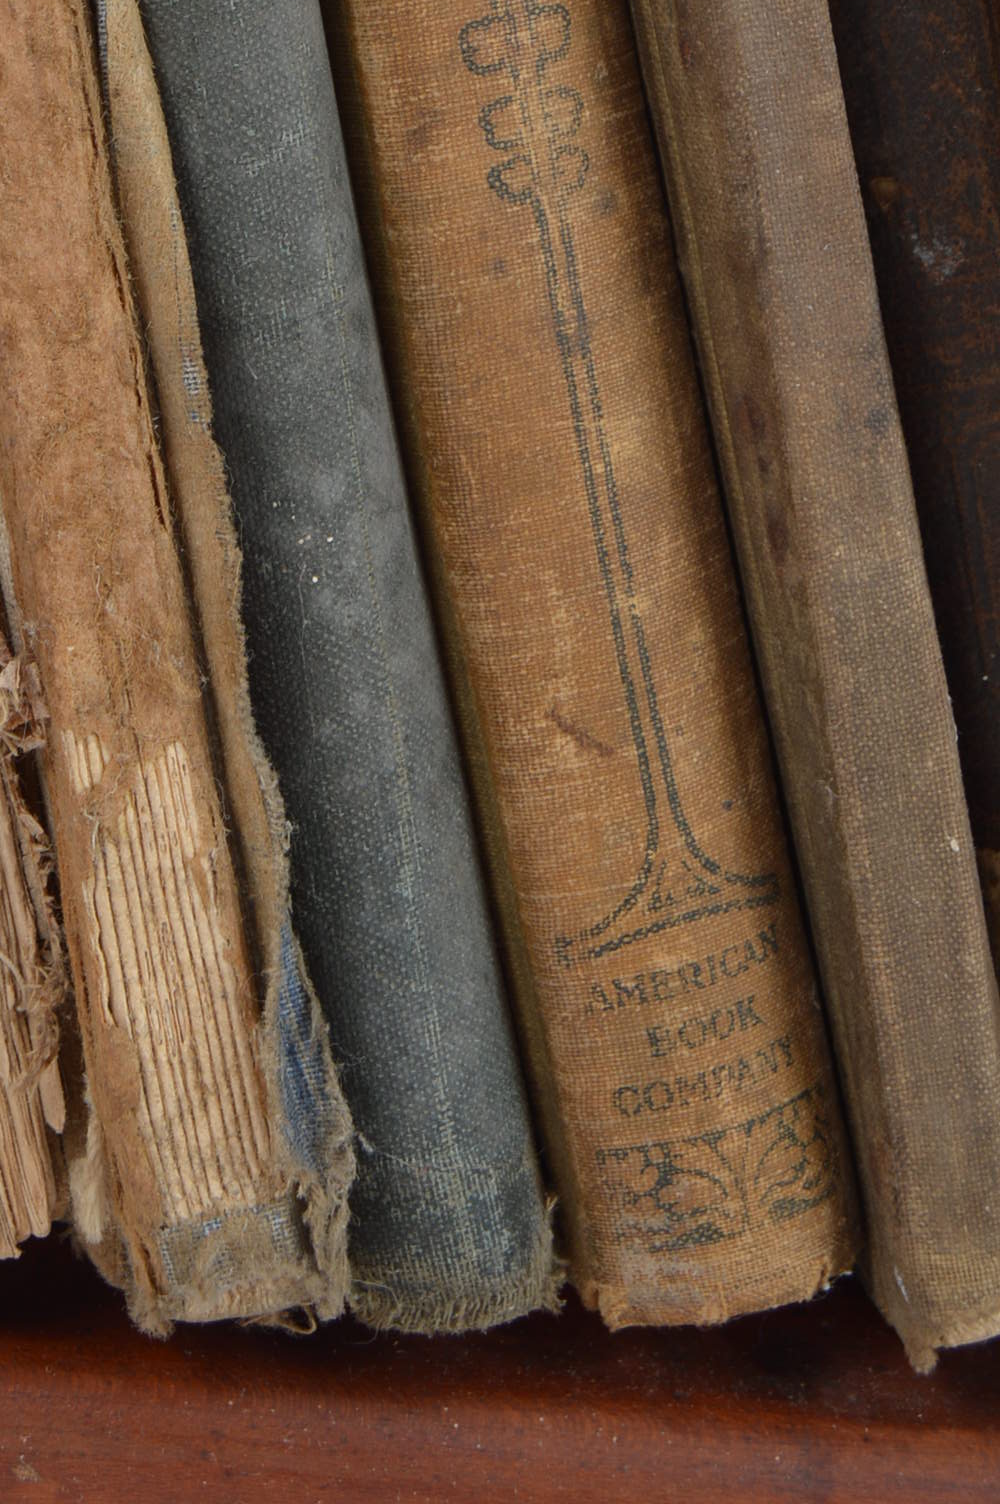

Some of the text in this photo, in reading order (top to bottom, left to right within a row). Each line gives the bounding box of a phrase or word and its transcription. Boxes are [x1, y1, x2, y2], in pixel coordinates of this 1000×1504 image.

[586, 923, 780, 1015] AMERICAN
[645, 995, 767, 1058] BOOK
[612, 1033, 794, 1118] COMPANY
